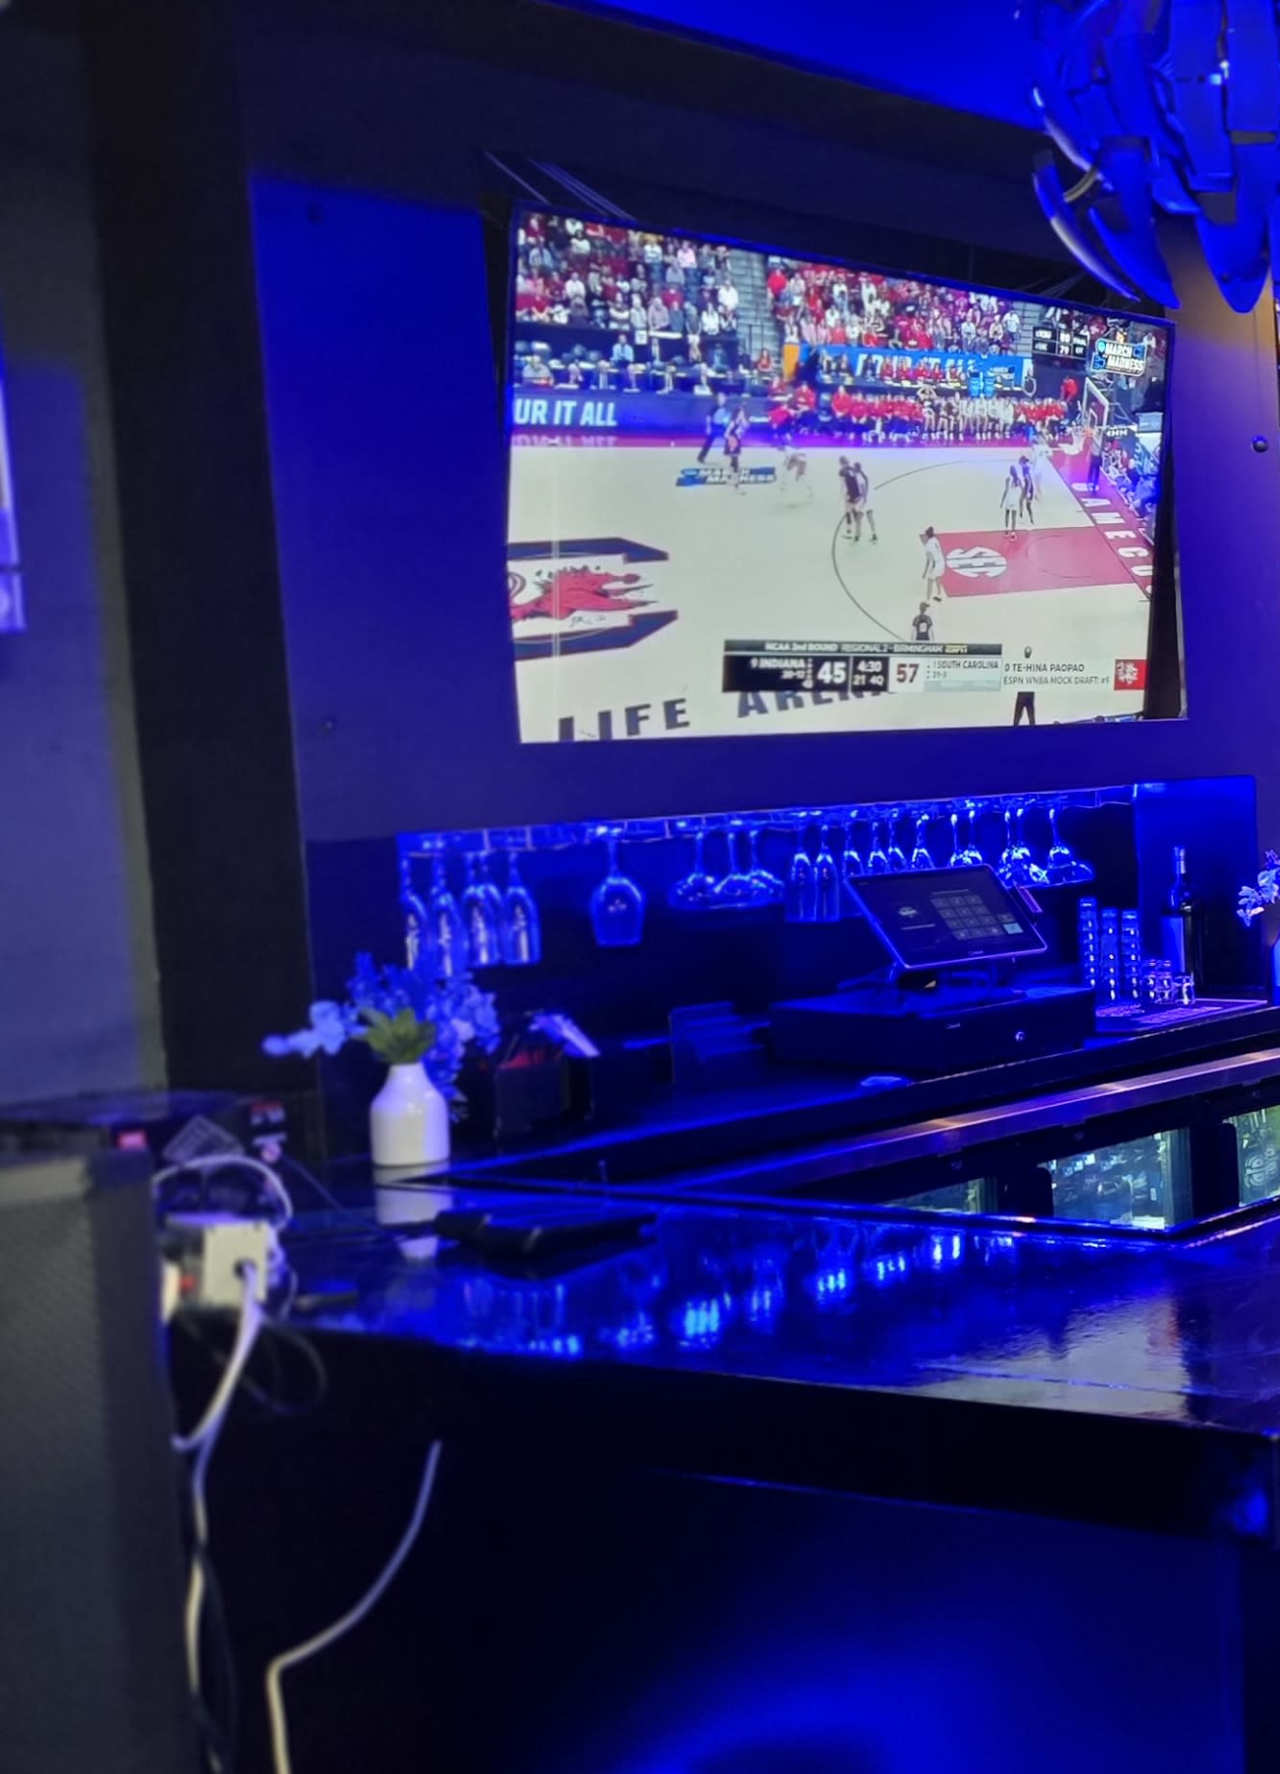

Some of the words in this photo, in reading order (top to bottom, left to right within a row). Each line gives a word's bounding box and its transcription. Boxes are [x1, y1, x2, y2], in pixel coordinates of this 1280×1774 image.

[1105, 342, 1132, 358] MARCH
[1106, 355, 1145, 371] MADNESS
[553, 400, 577, 426] IT
[579, 402, 618, 427] ALL
[758, 658, 806, 669] INDIANA
[937, 661, 961, 670] SOUTH
[963, 661, 999, 670] CAROLINA
[1013, 664, 1048, 673] TE-HINA
[1050, 664, 1086, 673] PAOPAO
[817, 661, 847, 684] 45
[896, 663, 920, 684] 57
[1003, 675, 1023, 686] ESPN
[1049, 676, 1072, 686] MOCK
